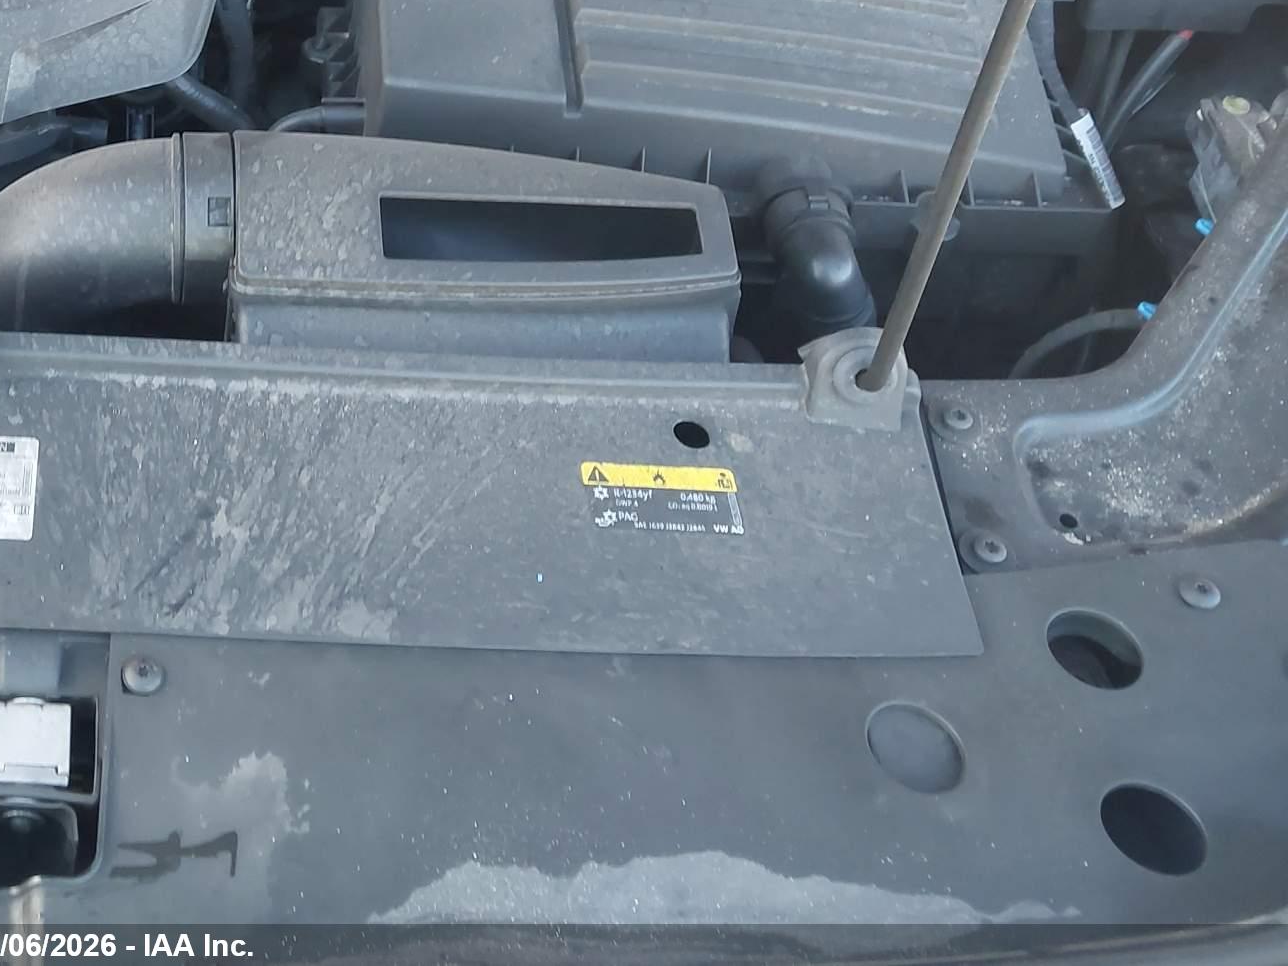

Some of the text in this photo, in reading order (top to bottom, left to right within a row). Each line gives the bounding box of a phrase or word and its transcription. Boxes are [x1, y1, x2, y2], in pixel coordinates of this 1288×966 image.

[613, 487, 652, 502] R-1234yf
[618, 510, 639, 522] PAG
[713, 522, 729, 534] VW
